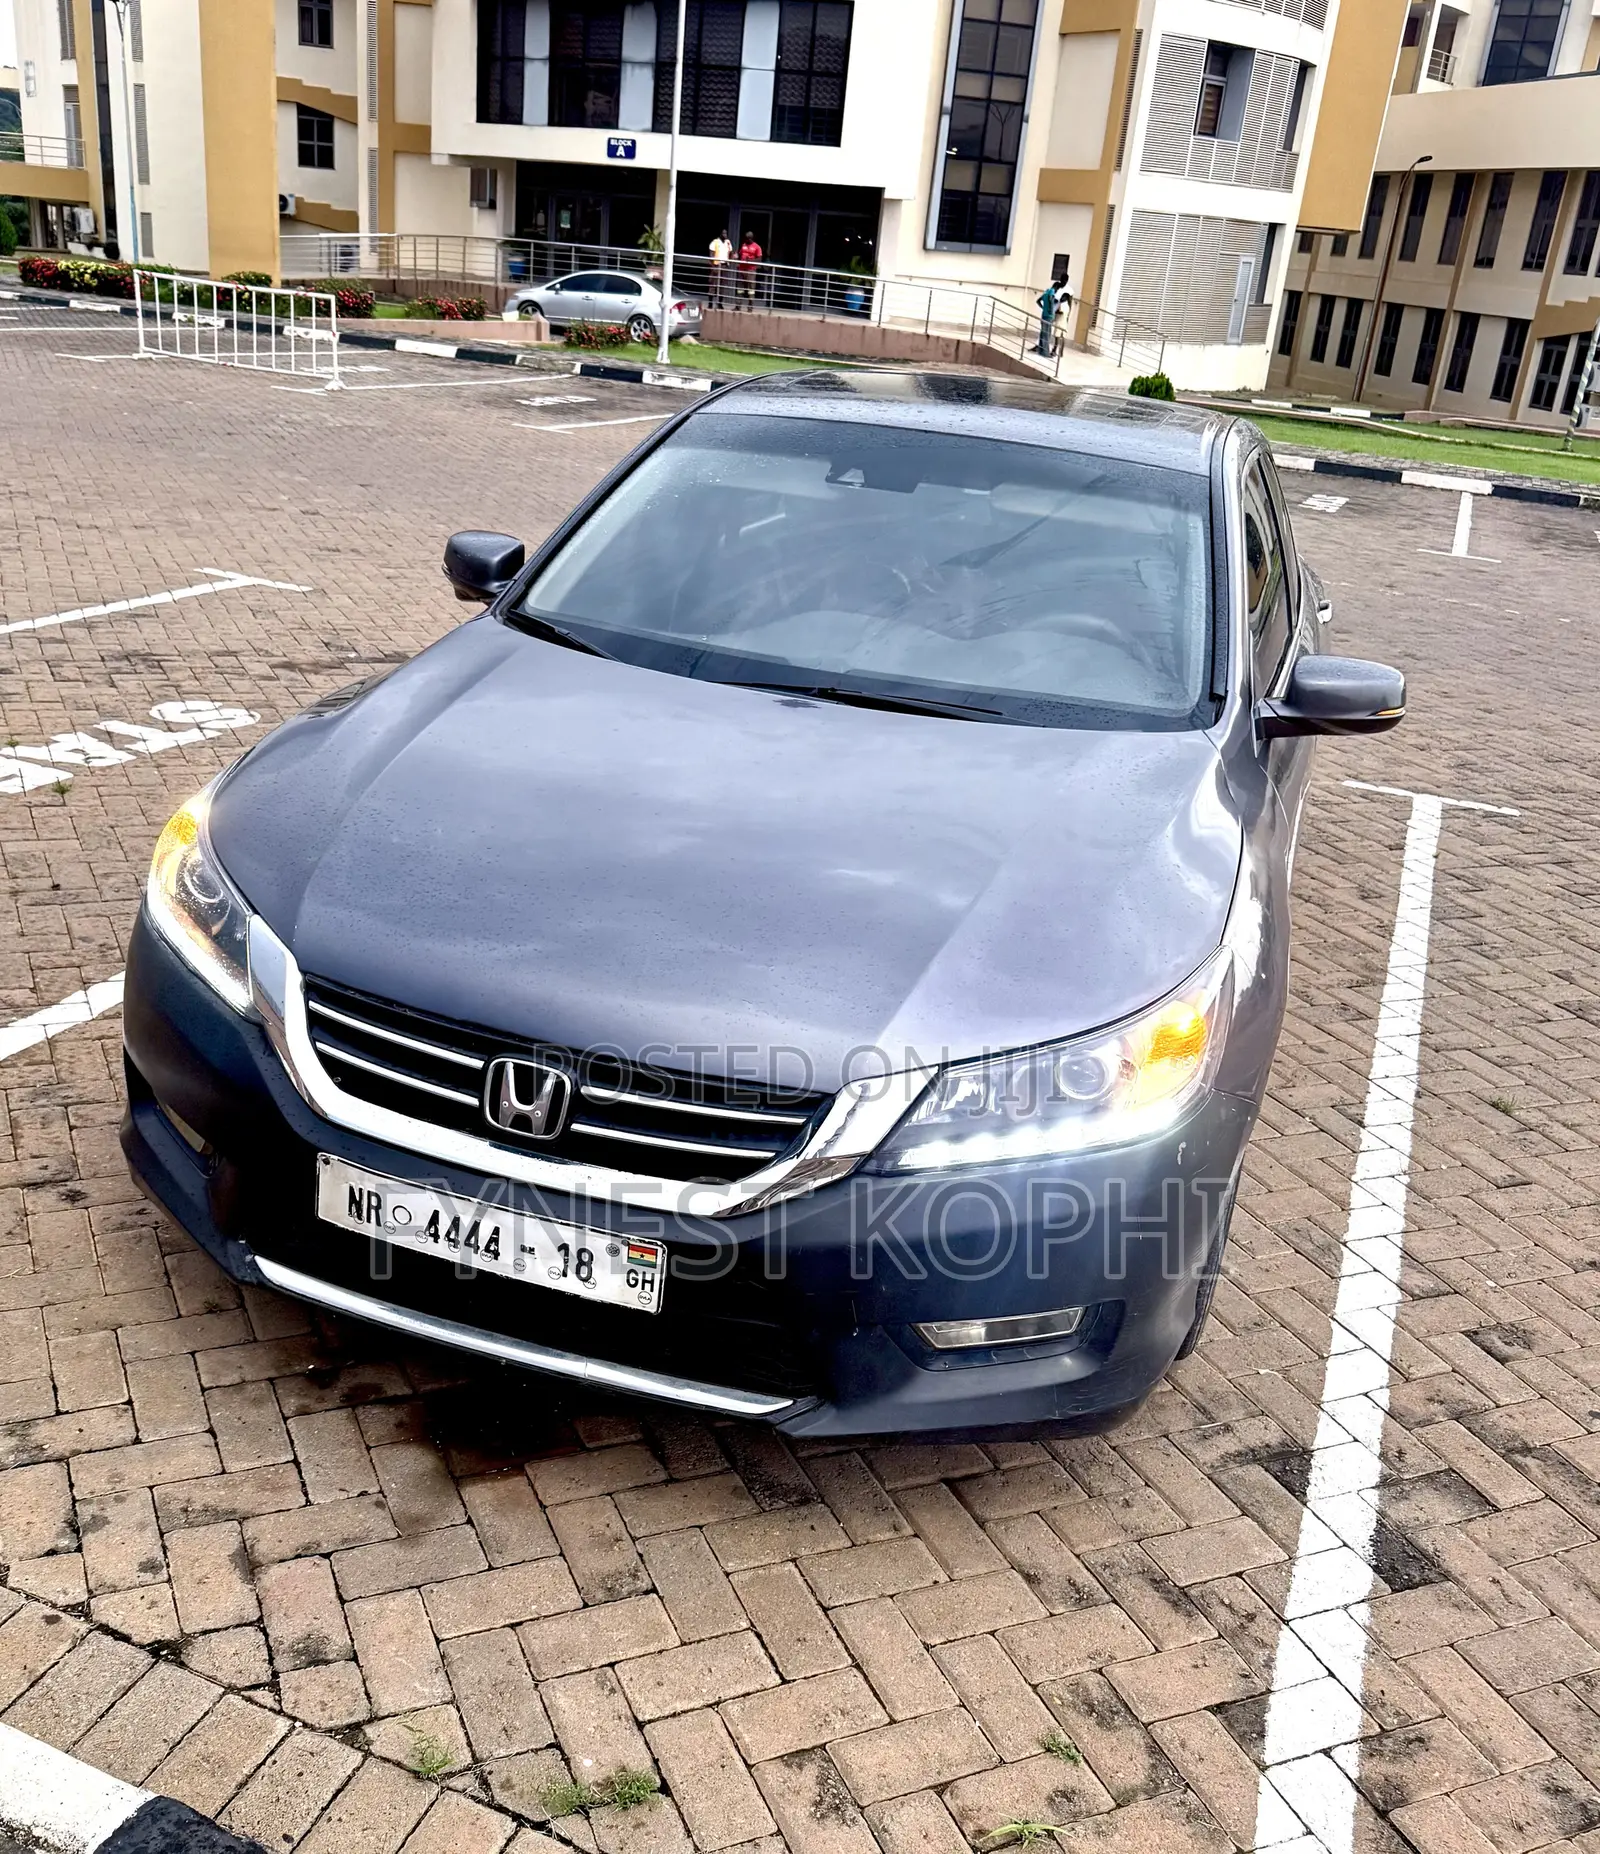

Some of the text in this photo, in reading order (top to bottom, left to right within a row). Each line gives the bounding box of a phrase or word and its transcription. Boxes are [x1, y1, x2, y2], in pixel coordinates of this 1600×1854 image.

[616, 145, 626, 157] A
[347, 1184, 383, 1227] NR
[424, 1209, 500, 1260] 4444
[557, 1242, 594, 1283] 18
[626, 1268, 655, 1292] GH
